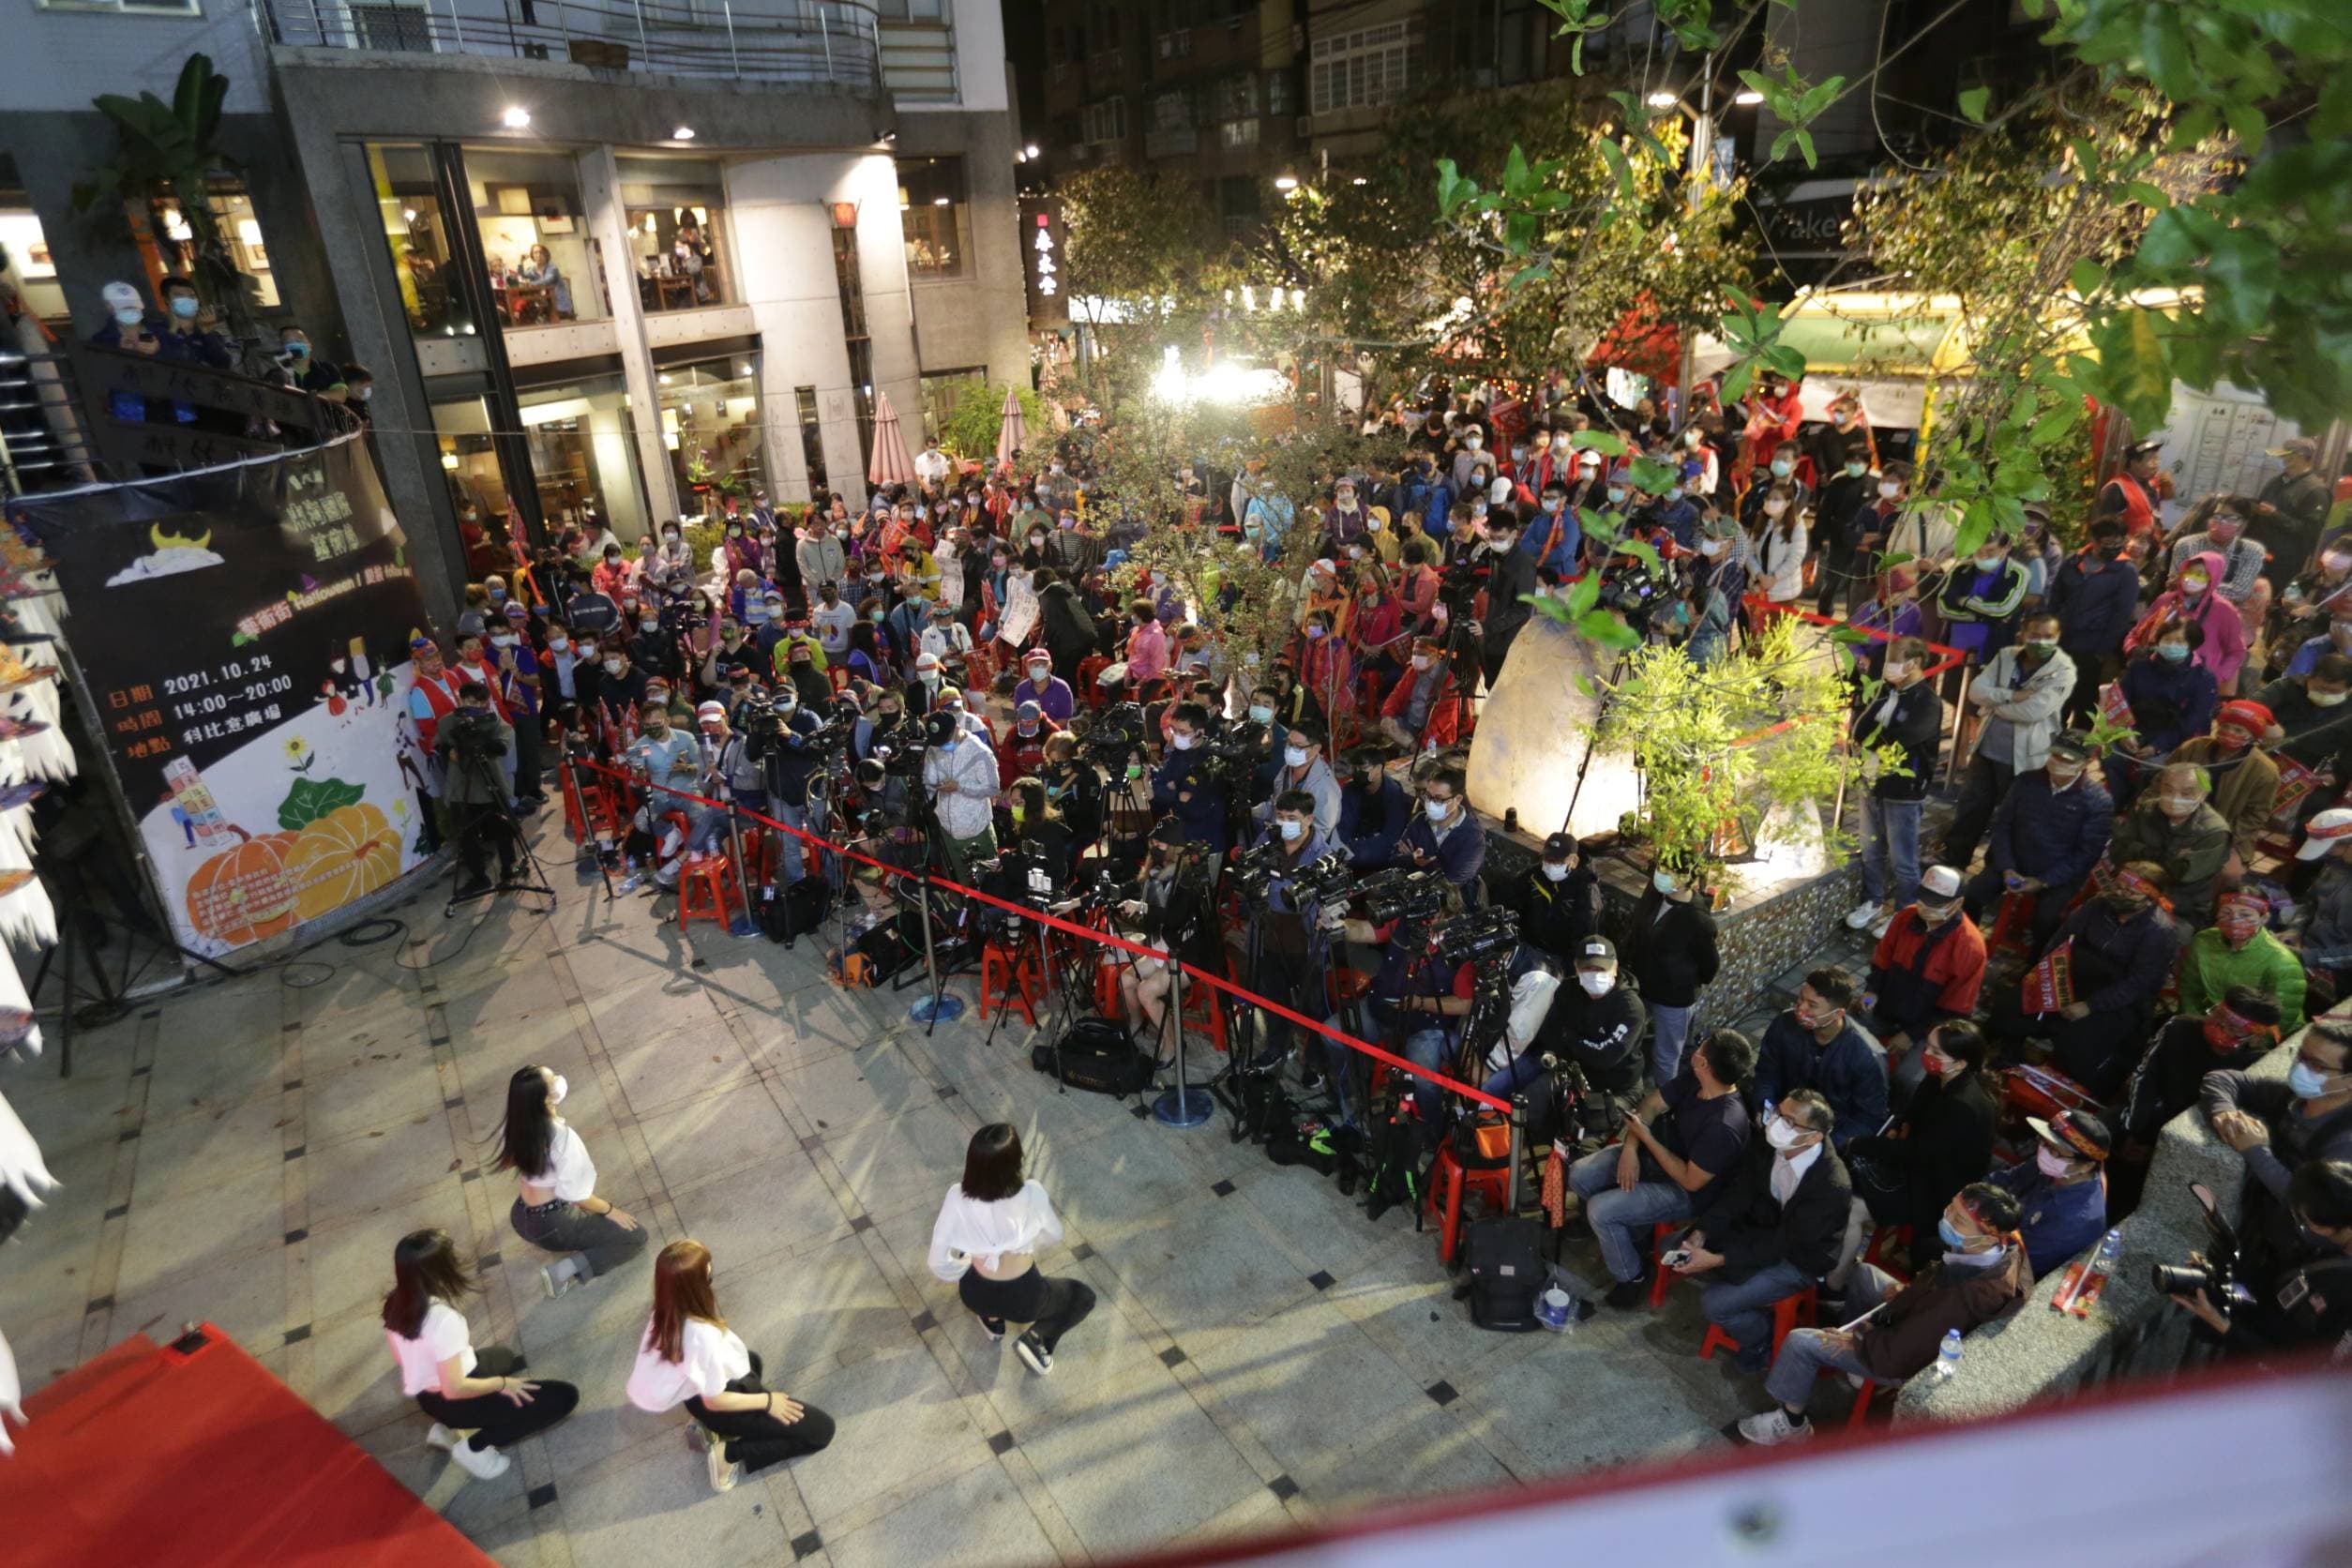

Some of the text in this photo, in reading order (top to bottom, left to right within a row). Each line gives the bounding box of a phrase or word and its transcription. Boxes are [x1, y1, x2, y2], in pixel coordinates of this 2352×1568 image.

[108, 655, 273, 708] 日期 2021.10.24
[116, 709, 163, 732] 時間
[127, 703, 282, 759] 地點 科比意廣場
